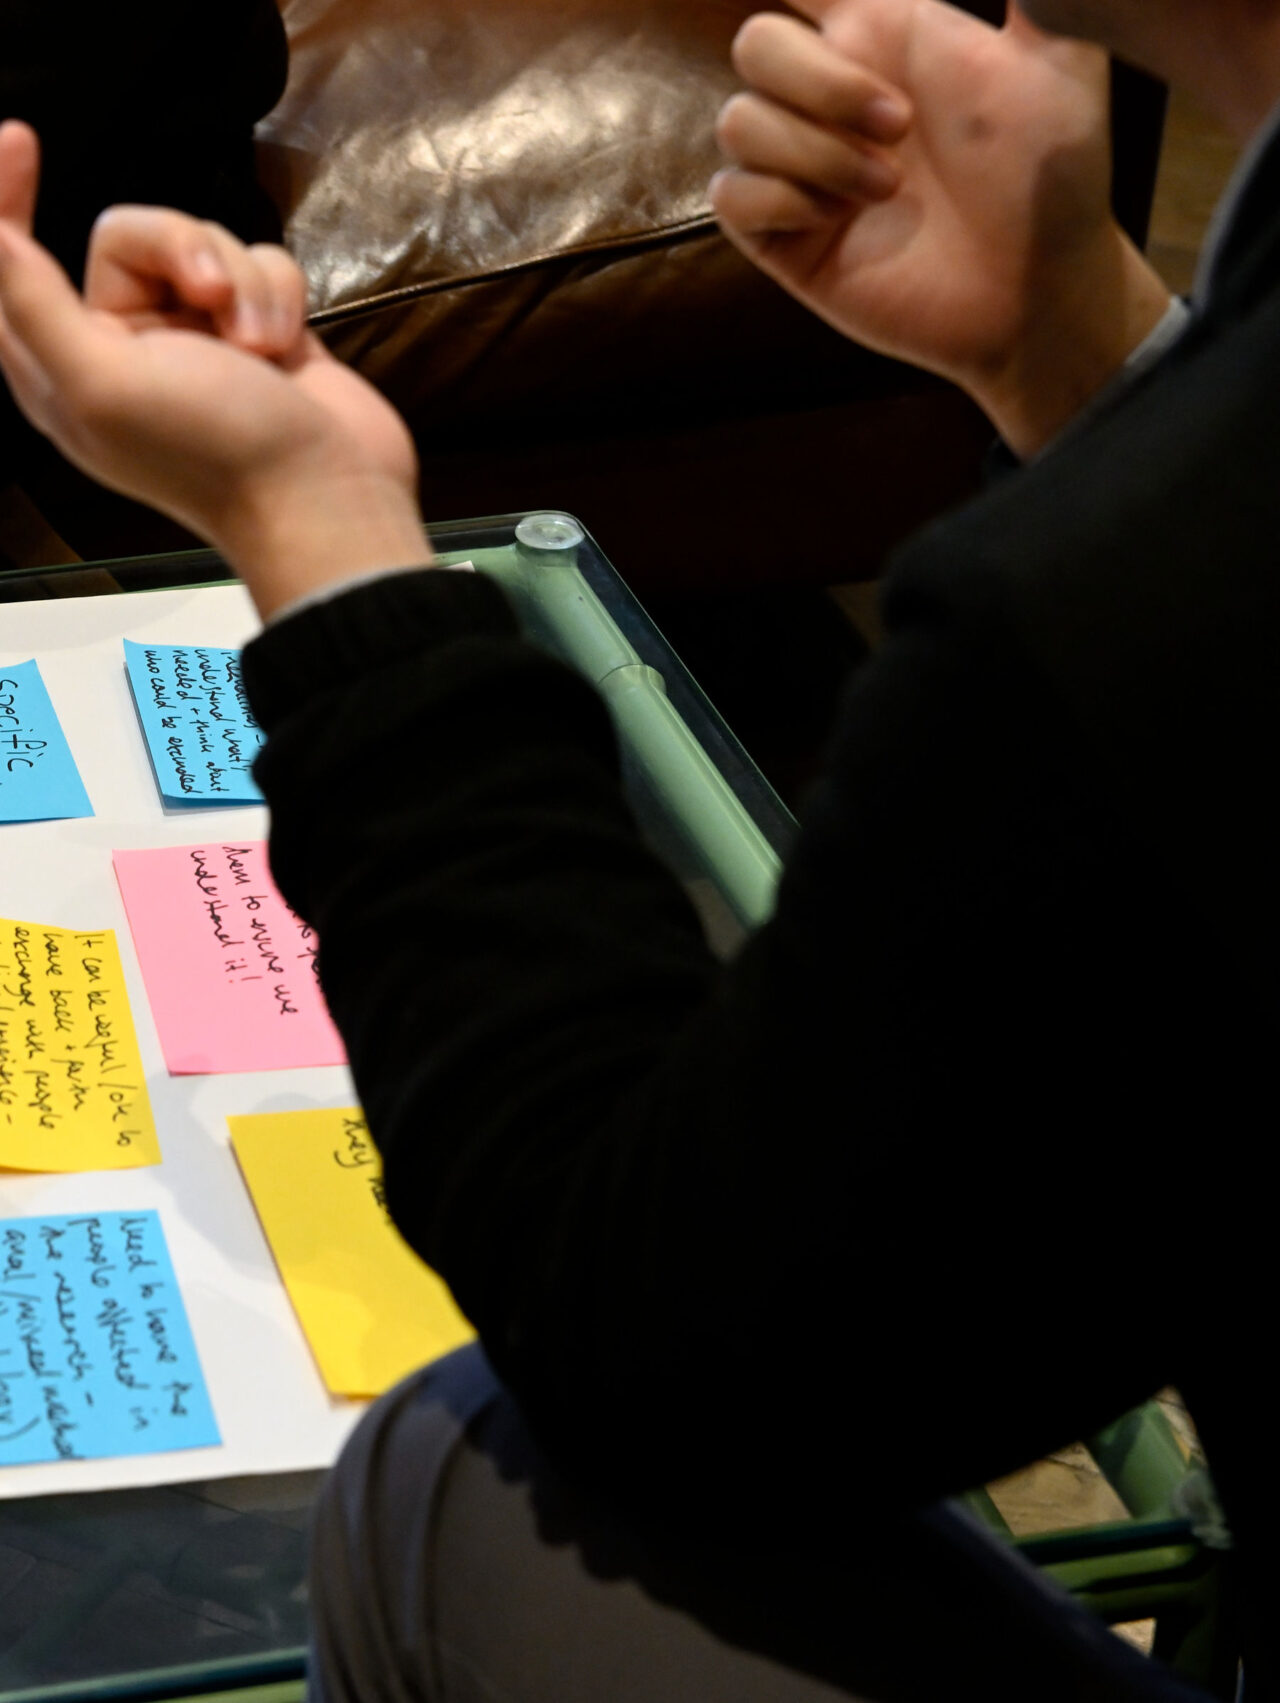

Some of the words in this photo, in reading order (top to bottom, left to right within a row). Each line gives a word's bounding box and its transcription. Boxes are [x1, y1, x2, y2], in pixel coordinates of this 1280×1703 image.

[144, 650, 162, 674] who
[151, 678, 176, 708] could
[194, 650, 236, 721] understand
[222, 729, 250, 762] what
[162, 716, 182, 729] be
[173, 650, 203, 700] needed
[190, 720, 215, 753] think
[206, 761, 230, 791] about
[166, 737, 203, 794] excluded
[191, 850, 245, 948] understand
[225, 958, 263, 983] it!
[43, 933, 63, 976] have
[75, 933, 105, 948] It
[241, 895, 268, 910] to
[275, 984, 298, 1016] we
[3, 927, 37, 1007] exchange
[82, 958, 101, 983] can
[49, 989, 73, 1032] back
[88, 989, 110, 1011] be
[25, 1020, 44, 1058] with
[84, 1014, 126, 1073] useful
[23, 1070, 62, 1130] people
[117, 1130, 141, 1147] to
[67, 1218, 116, 1287] people
[96, 1298, 150, 1389] affected
[139, 1282, 165, 1299] to
